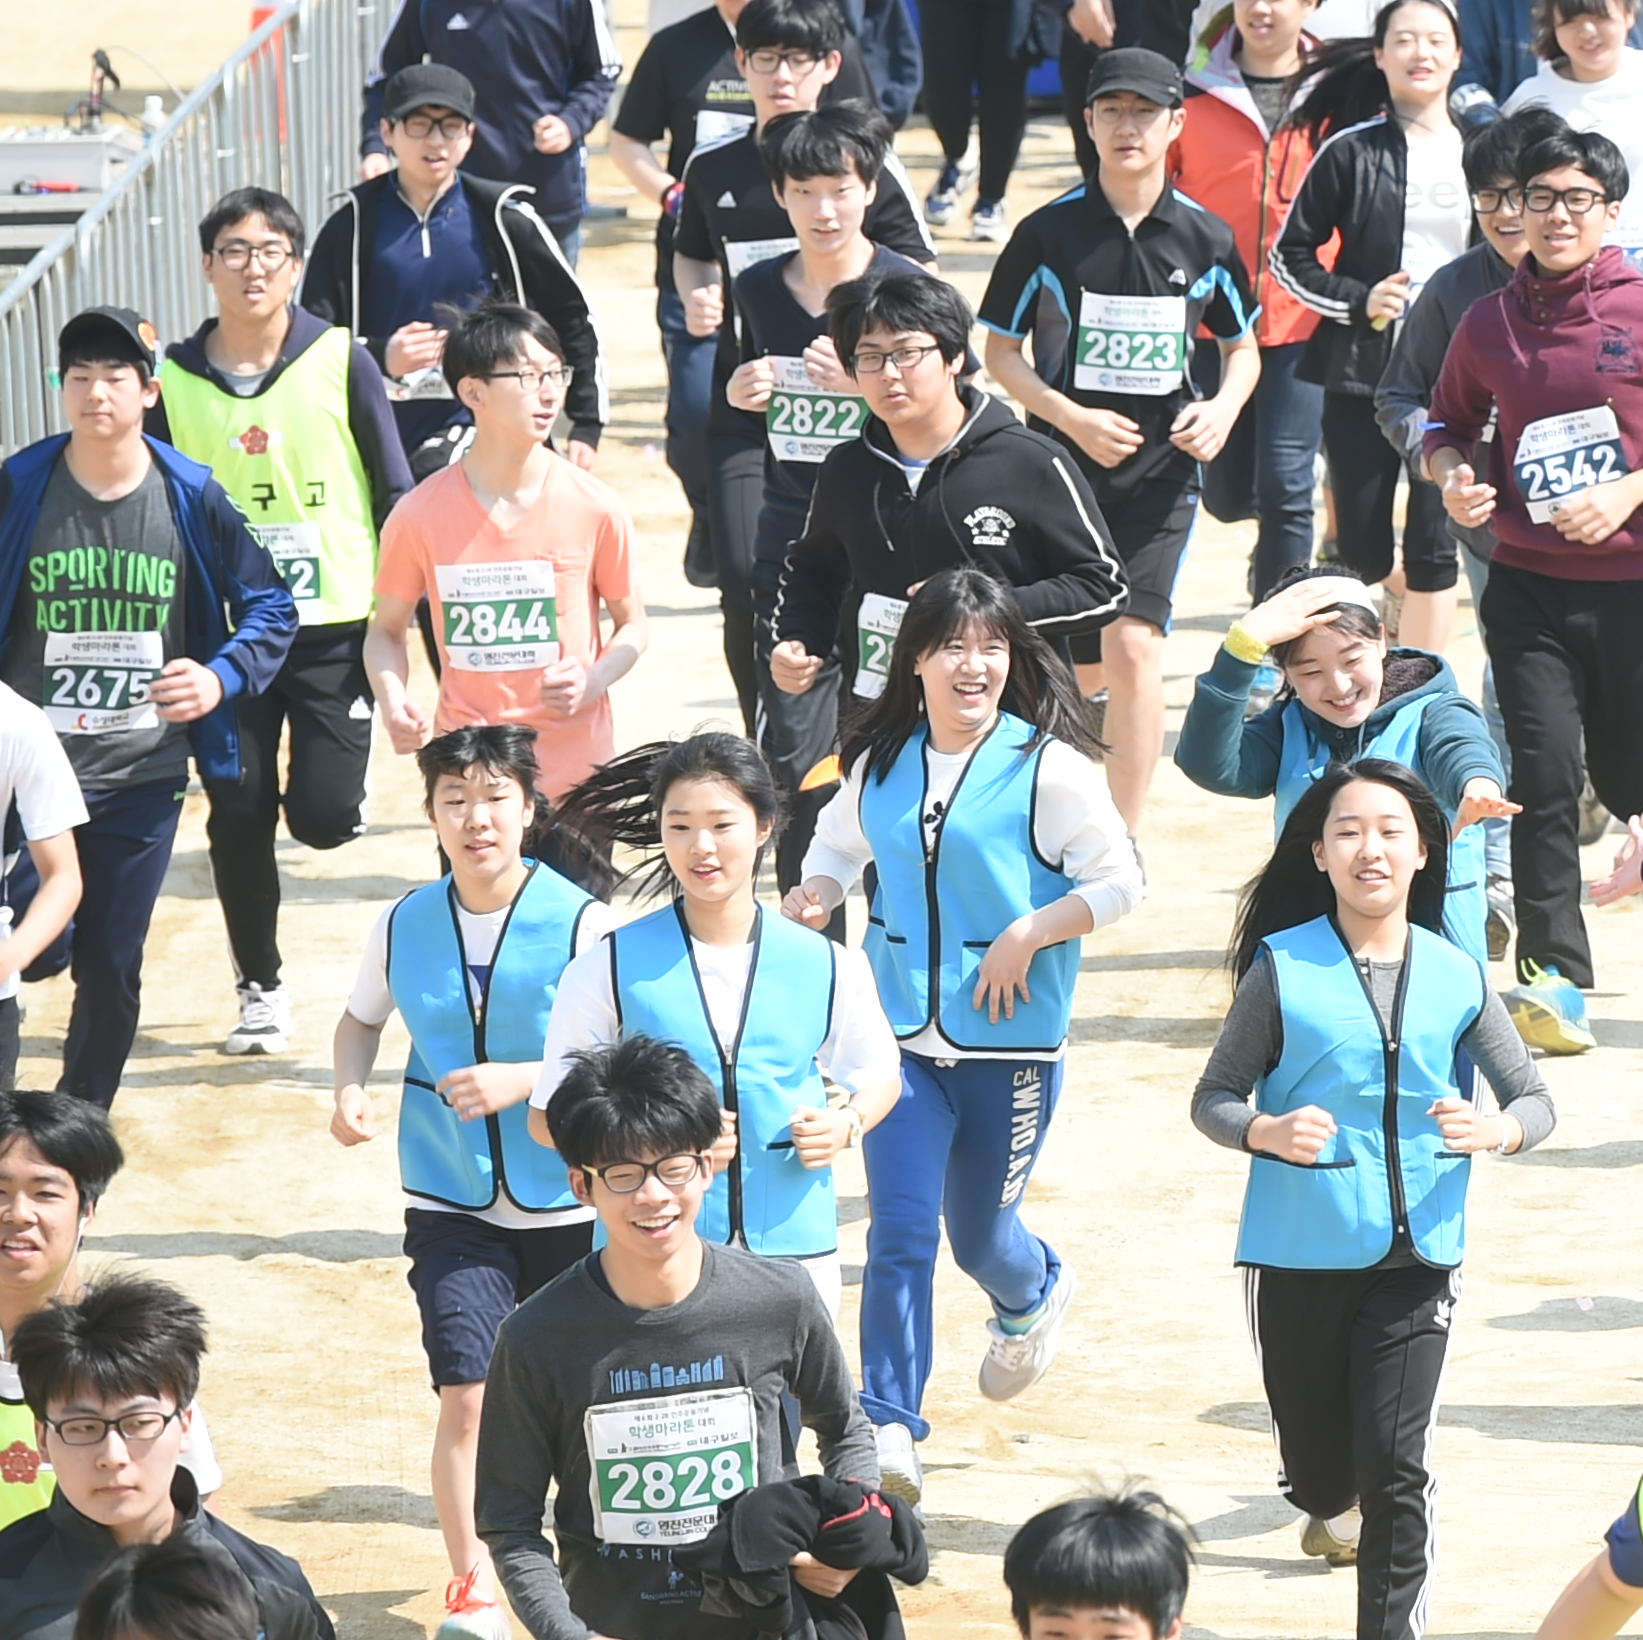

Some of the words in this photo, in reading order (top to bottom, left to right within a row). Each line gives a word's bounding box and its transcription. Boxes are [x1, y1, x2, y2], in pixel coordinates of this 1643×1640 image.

[1084, 330, 1178, 370] 2823
[771, 395, 862, 437] 2822
[1521, 444, 1623, 501] 2542
[29, 546, 177, 598] SPORTING
[37, 597, 170, 632] ACTIVITY
[449, 601, 551, 644] 2844
[51, 667, 153, 709] 2675
[1012, 1065, 1041, 1087] CAL
[628, 1418, 696, 1439] 학생마라톤
[697, 1417, 716, 1427] 대회
[607, 1449, 745, 1510] 2828
[657, 1514, 718, 1531] 영진전문대
